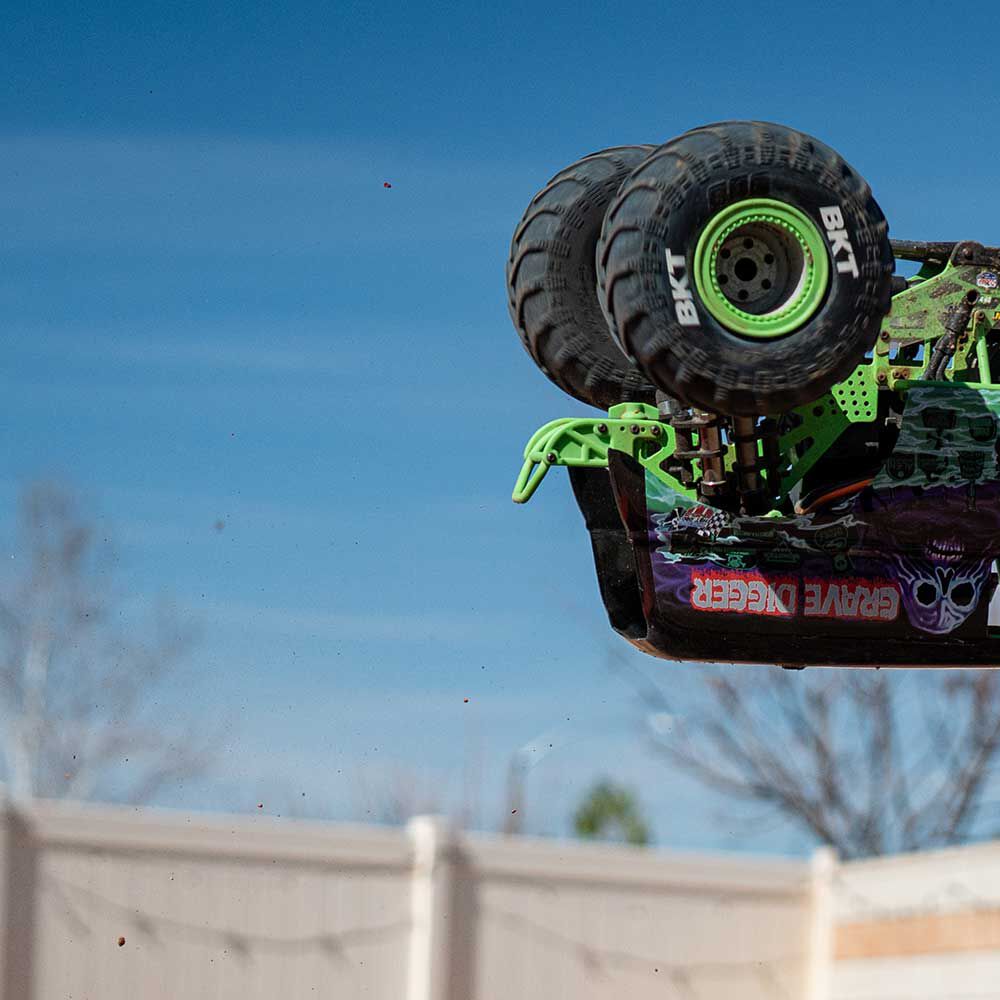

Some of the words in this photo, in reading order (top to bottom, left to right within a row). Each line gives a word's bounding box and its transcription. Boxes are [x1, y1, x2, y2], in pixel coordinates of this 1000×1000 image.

[819, 205, 859, 279] BKT
[665, 248, 700, 327] BKT
[693, 578, 797, 614] DIGGER
[804, 584, 899, 620] GRAVE
